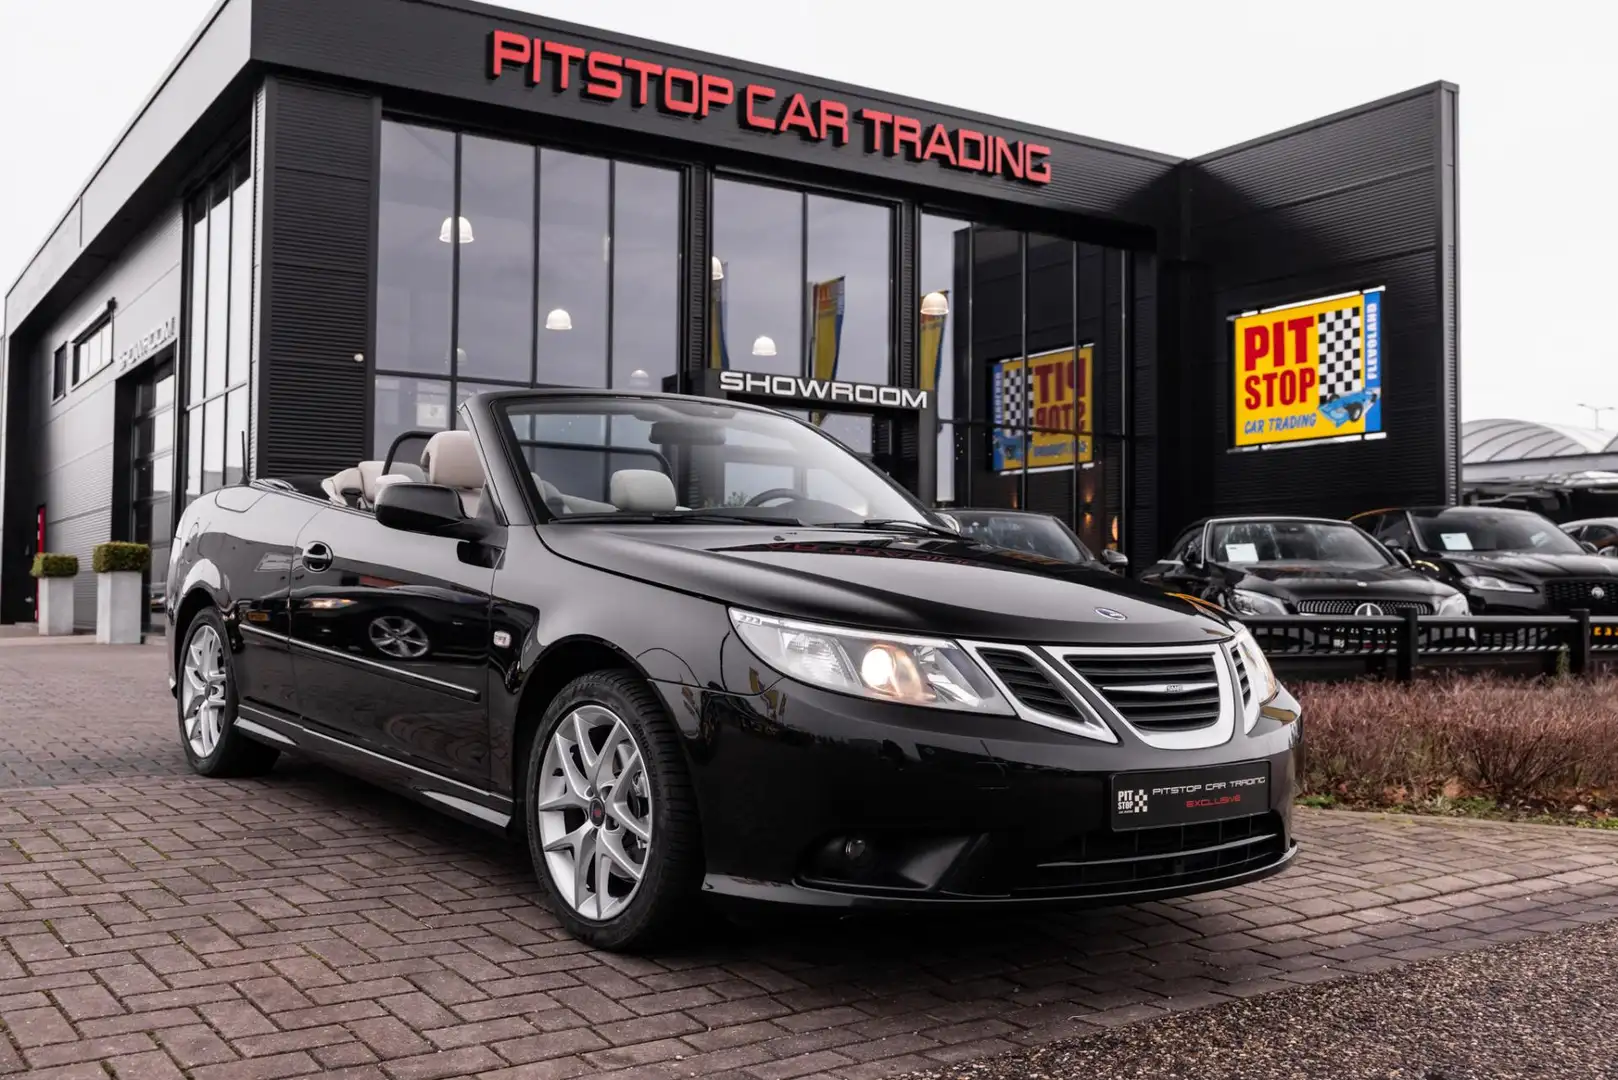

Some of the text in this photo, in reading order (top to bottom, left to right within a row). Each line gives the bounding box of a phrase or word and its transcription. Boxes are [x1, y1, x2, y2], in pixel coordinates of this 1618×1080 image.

[492, 29, 1052, 184] PITSTOP CAR TRADING
[1244, 316, 1315, 372] PIT
[1366, 302, 1378, 381] FLEVOLAND
[719, 370, 928, 409] SHOWROOM
[1244, 367, 1316, 411] STOP
[1244, 413, 1317, 435] CAR TRADING
[1118, 790, 1133, 801] PIT
[1152, 785, 1202, 795] PITSTOP
[1205, 780, 1227, 791] CAR
[1185, 794, 1241, 808] EXCLUSIVE
[1117, 801, 1134, 809] STOP
